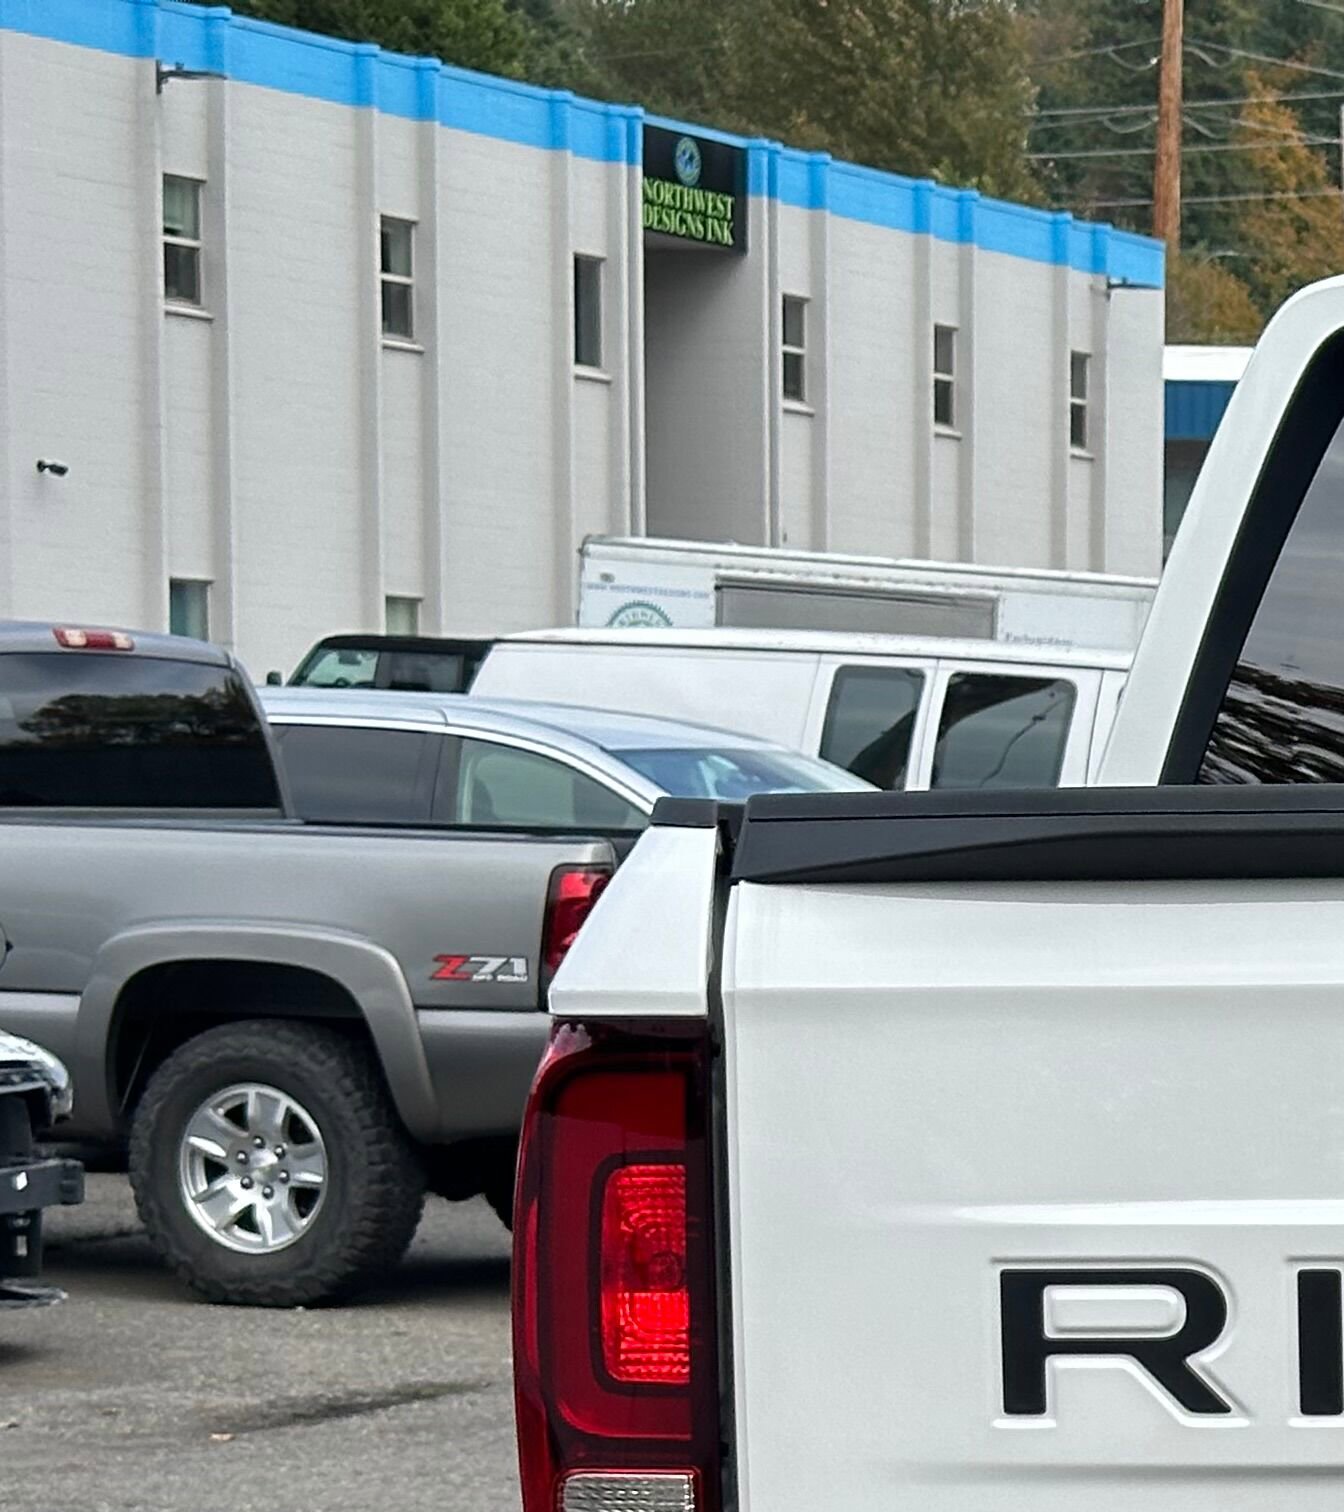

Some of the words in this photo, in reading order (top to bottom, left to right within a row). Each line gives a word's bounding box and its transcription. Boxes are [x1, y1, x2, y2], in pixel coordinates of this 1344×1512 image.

[643, 177, 735, 220] NORTHWEST
[643, 203, 704, 239] DESIGNS
[706, 218, 735, 246] INK
[431, 954, 528, 981] Z71
